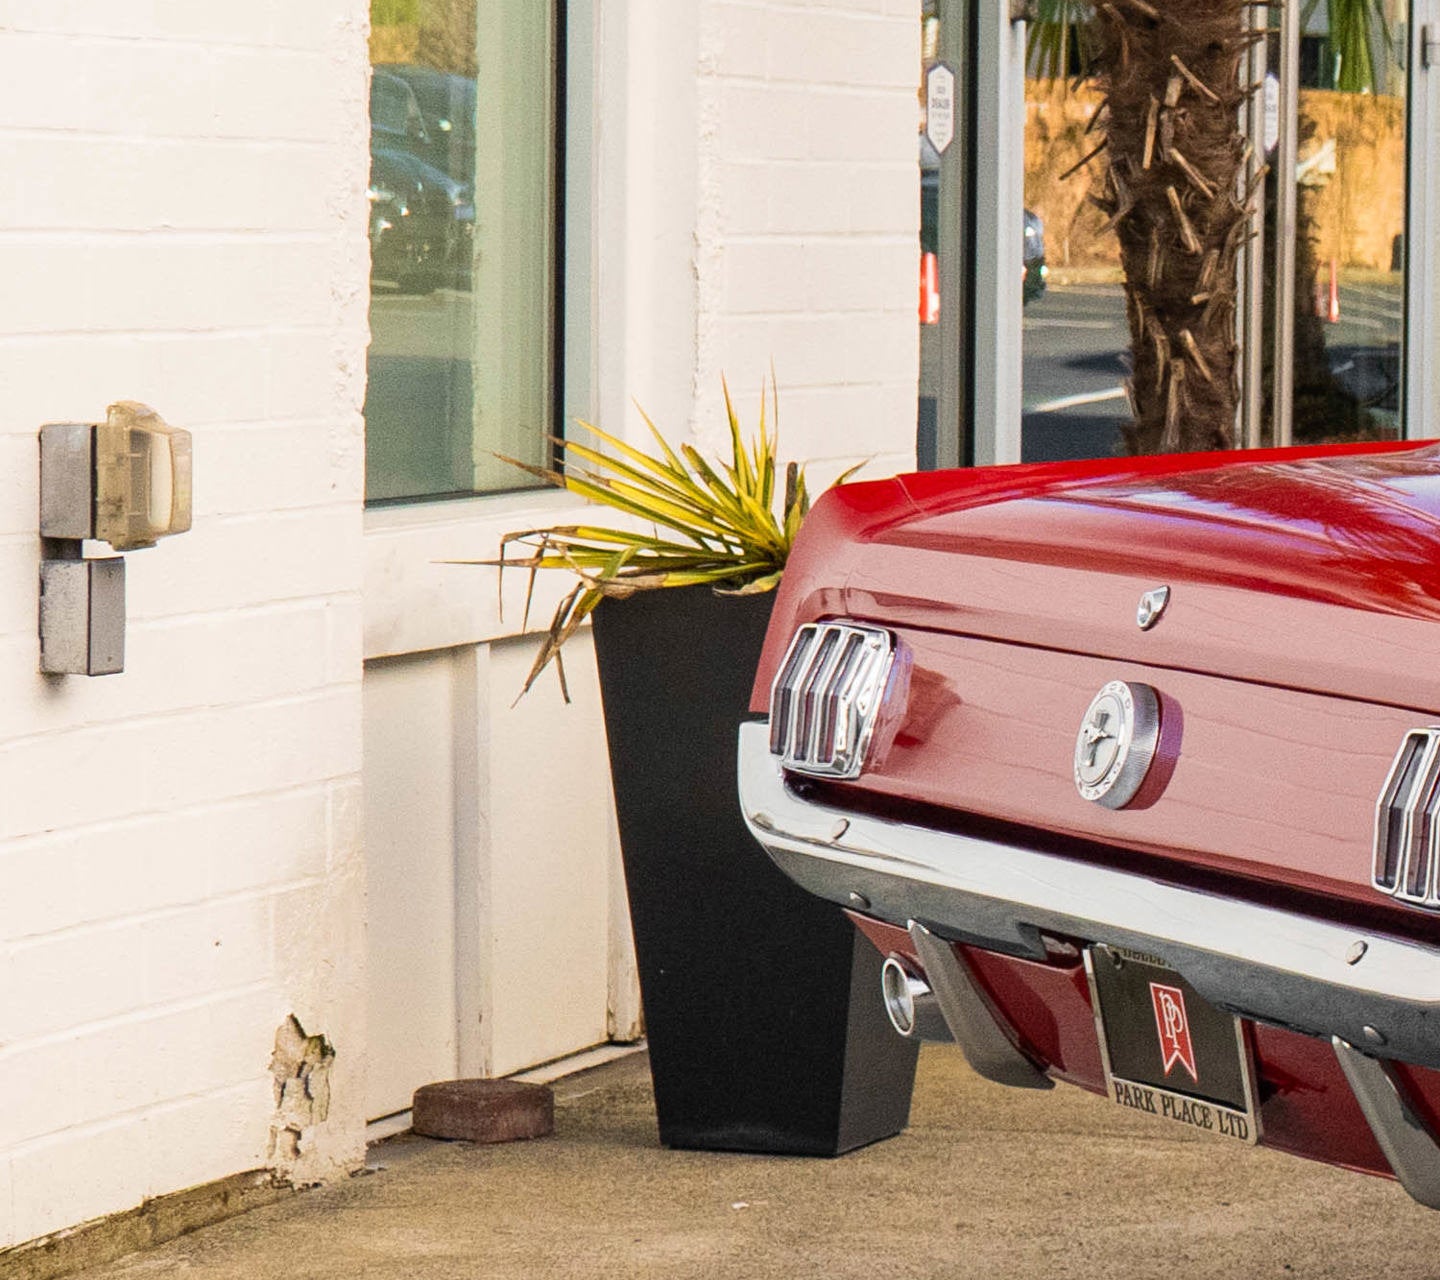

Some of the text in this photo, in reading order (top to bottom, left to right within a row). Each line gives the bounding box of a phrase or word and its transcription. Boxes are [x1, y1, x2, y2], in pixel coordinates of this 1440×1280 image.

[1114, 1081, 1249, 1140] PARK PLACE LTD
